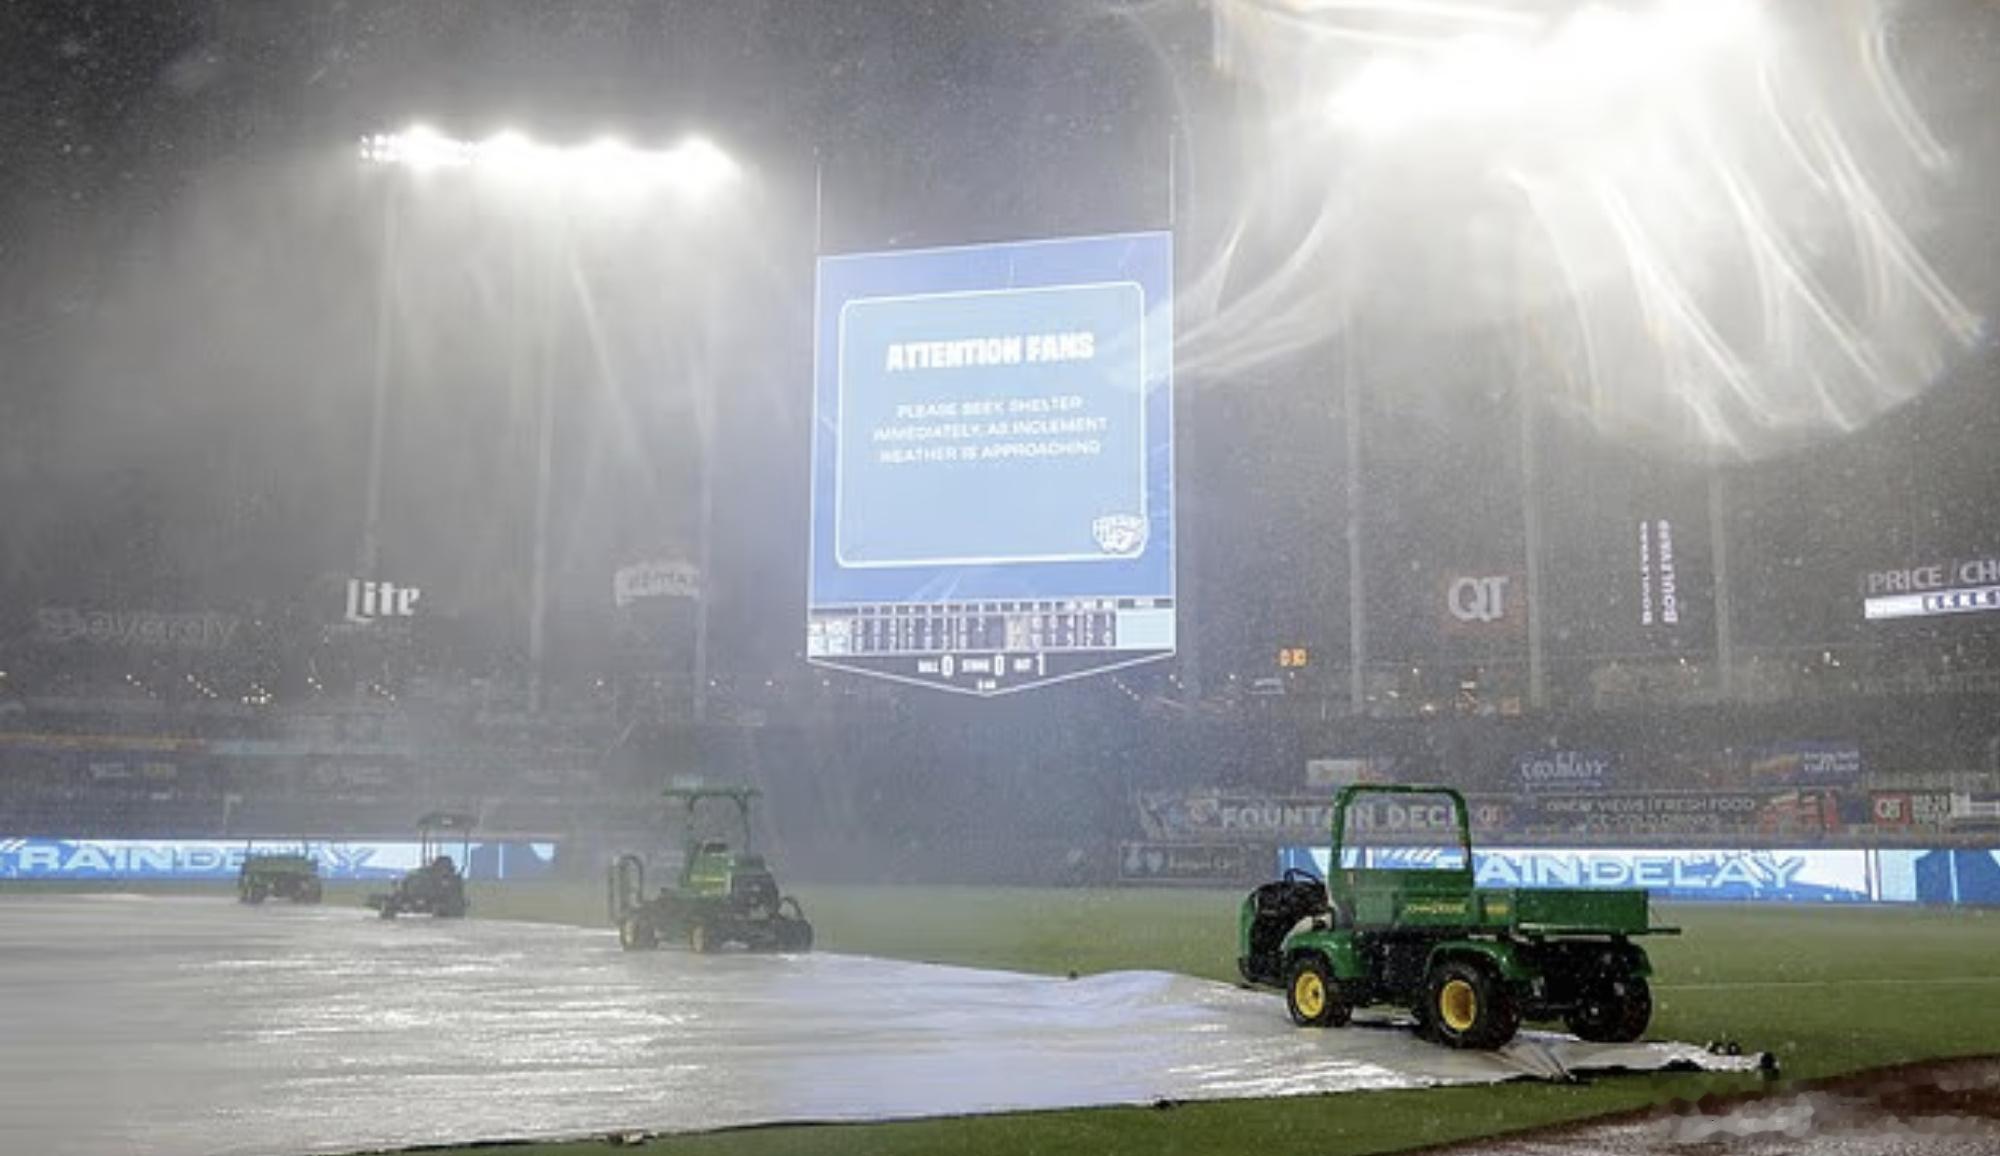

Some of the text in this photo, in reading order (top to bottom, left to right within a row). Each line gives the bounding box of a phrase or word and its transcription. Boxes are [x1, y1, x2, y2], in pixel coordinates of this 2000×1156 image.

[886, 332, 1095, 371] ATTENTION FANS
[897, 396, 1082, 419] PLEASE SEEK SHELTER
[1013, 416, 1107, 435] INCLEMENT
[880, 440, 1101, 463] WEATHER IS APPROACHING
[1868, 559, 2000, 593] PRICE CH
[345, 578, 420, 624] Lite
[1449, 576, 1509, 622] QT
[1223, 804, 1375, 829] FOUNTIN
